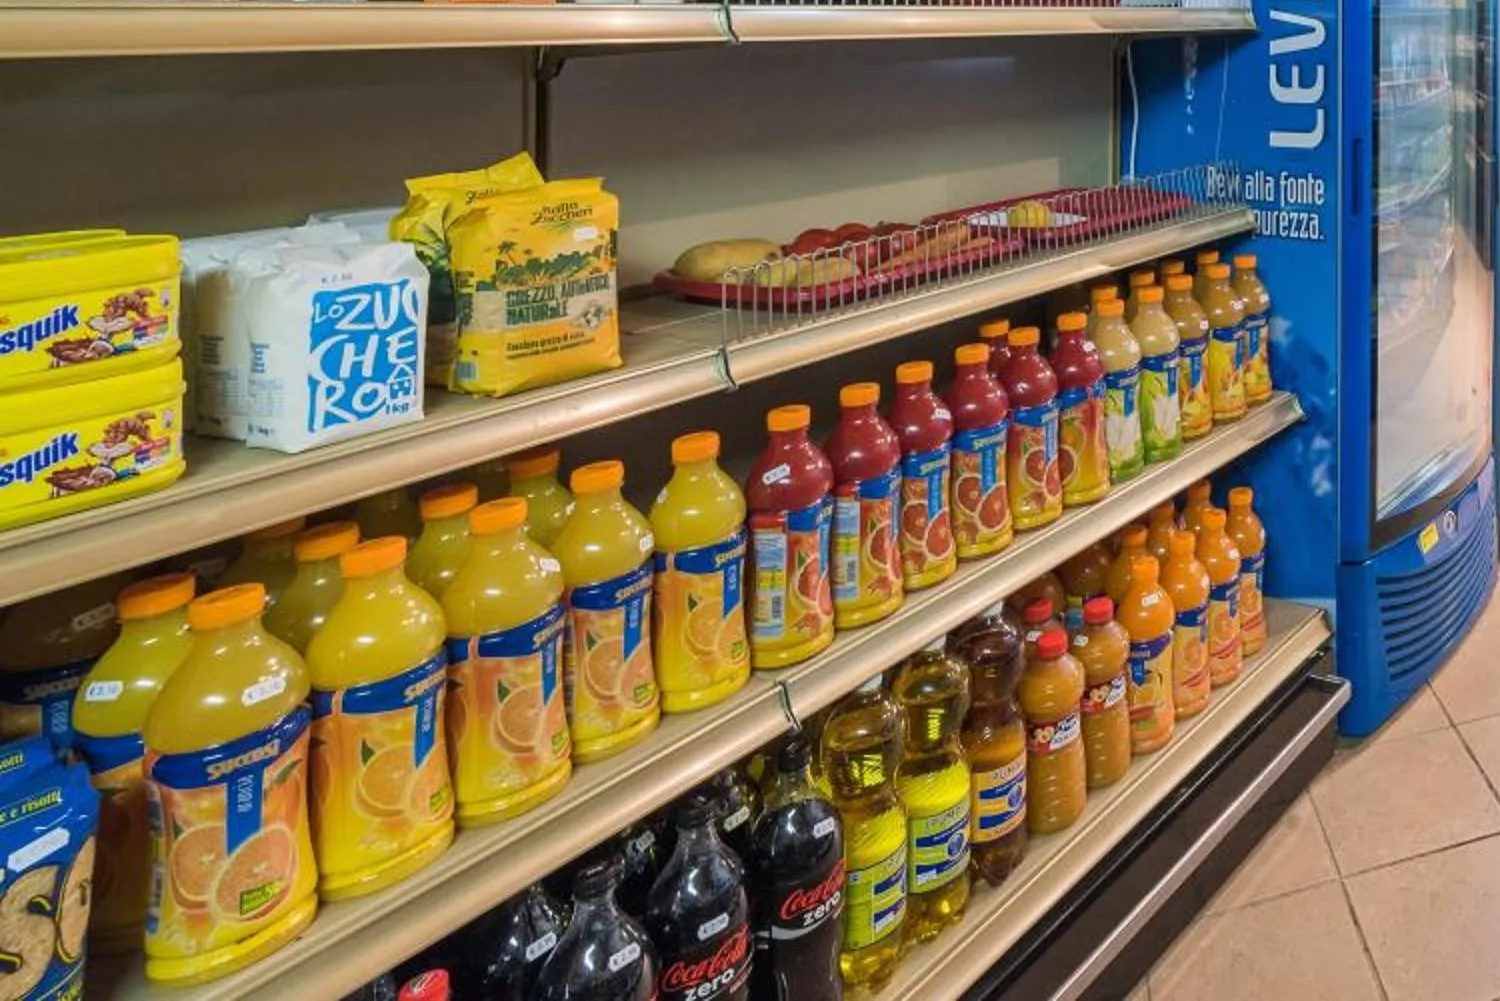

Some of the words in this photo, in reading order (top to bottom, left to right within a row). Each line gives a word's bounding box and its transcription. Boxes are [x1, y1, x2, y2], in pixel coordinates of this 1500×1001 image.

[1245, 170, 1275, 203] alla
[1280, 171, 1325, 207] fonte
[803, 890, 842, 926] zero
